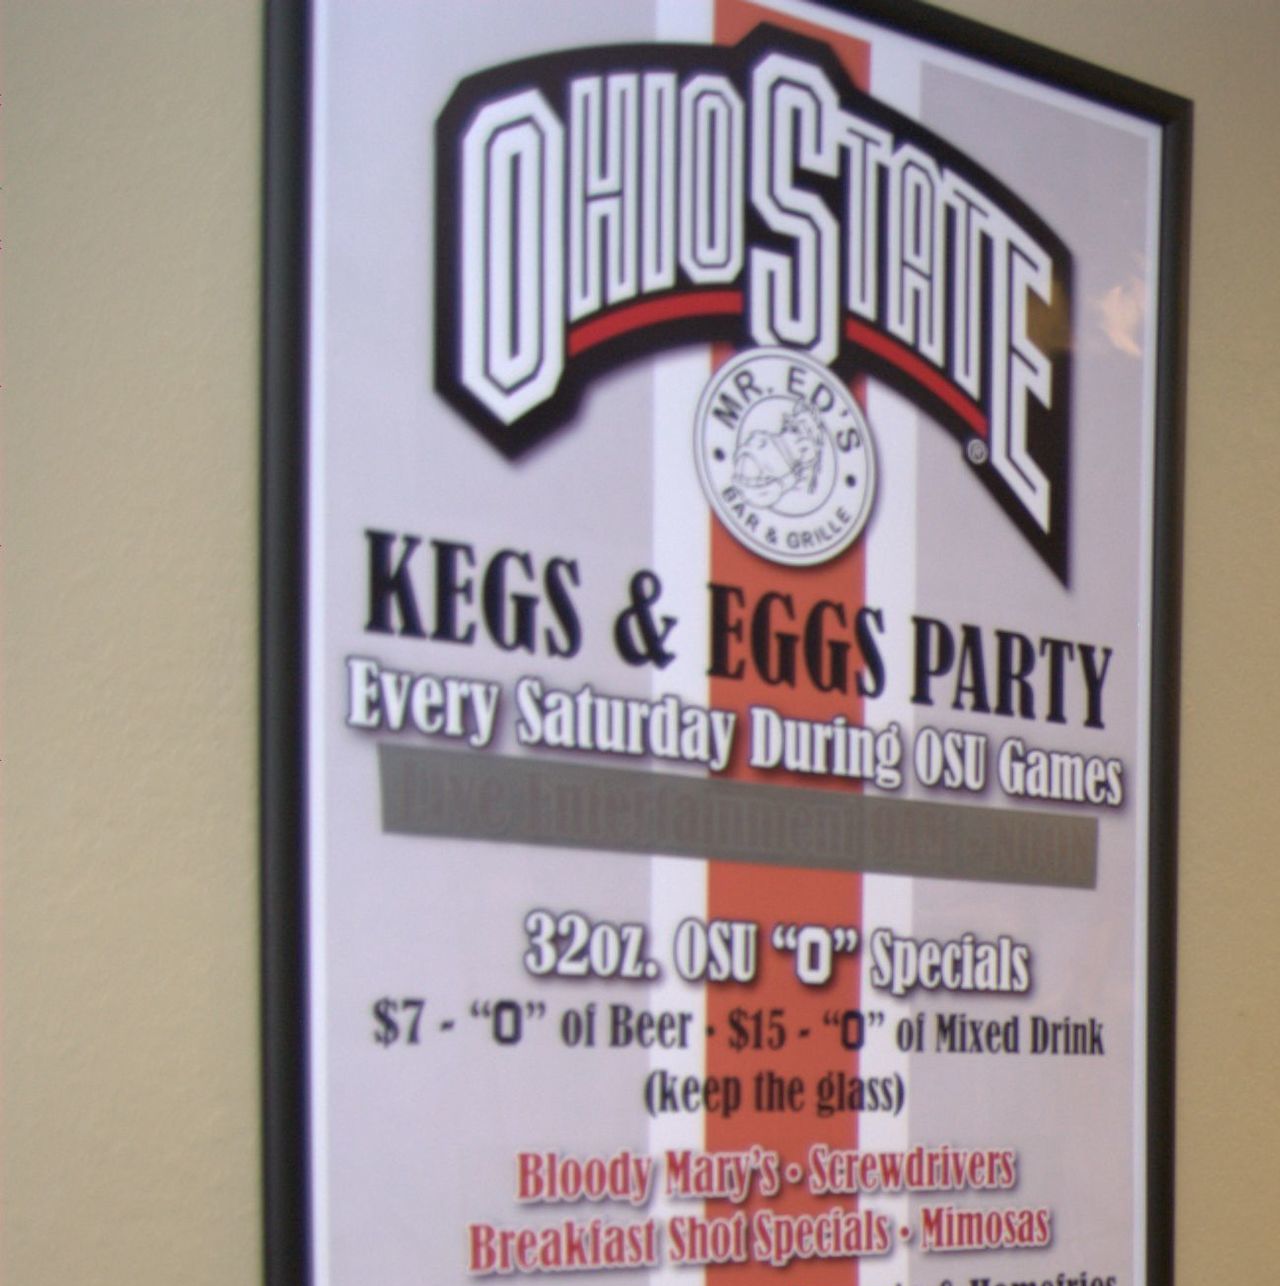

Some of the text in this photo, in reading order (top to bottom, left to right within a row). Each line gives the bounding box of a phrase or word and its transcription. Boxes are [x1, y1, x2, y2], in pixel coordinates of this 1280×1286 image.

[461, 52, 1052, 535] OHIO STATE
[712, 365, 862, 454] MR. ED'S
[721, 486, 852, 551] BAR & GRILLE
[364, 528, 1113, 730] KEGS & EGGS PARTY
[347, 657, 1124, 806] Every Saturday During OSU Games
[523, 911, 658, 979] 32oz.
[673, 917, 759, 983] OSU
[870, 928, 1033, 998] Specials
[372, 996, 427, 1048] $7
[560, 1002, 598, 1048] of
[608, 1003, 693, 1050] Beer
[728, 1007, 788, 1054] $15
[896, 1011, 927, 1054] of
[935, 1013, 1020, 1055] Mixed
[1029, 1014, 1106, 1056] Drink
[643, 1068, 907, 1119] (keep the glass)
[515, 1145, 1017, 1204] Bloody Mary's Screwdrivers
[468, 1205, 1050, 1273] Breakfast Shot Specials Mimosas
